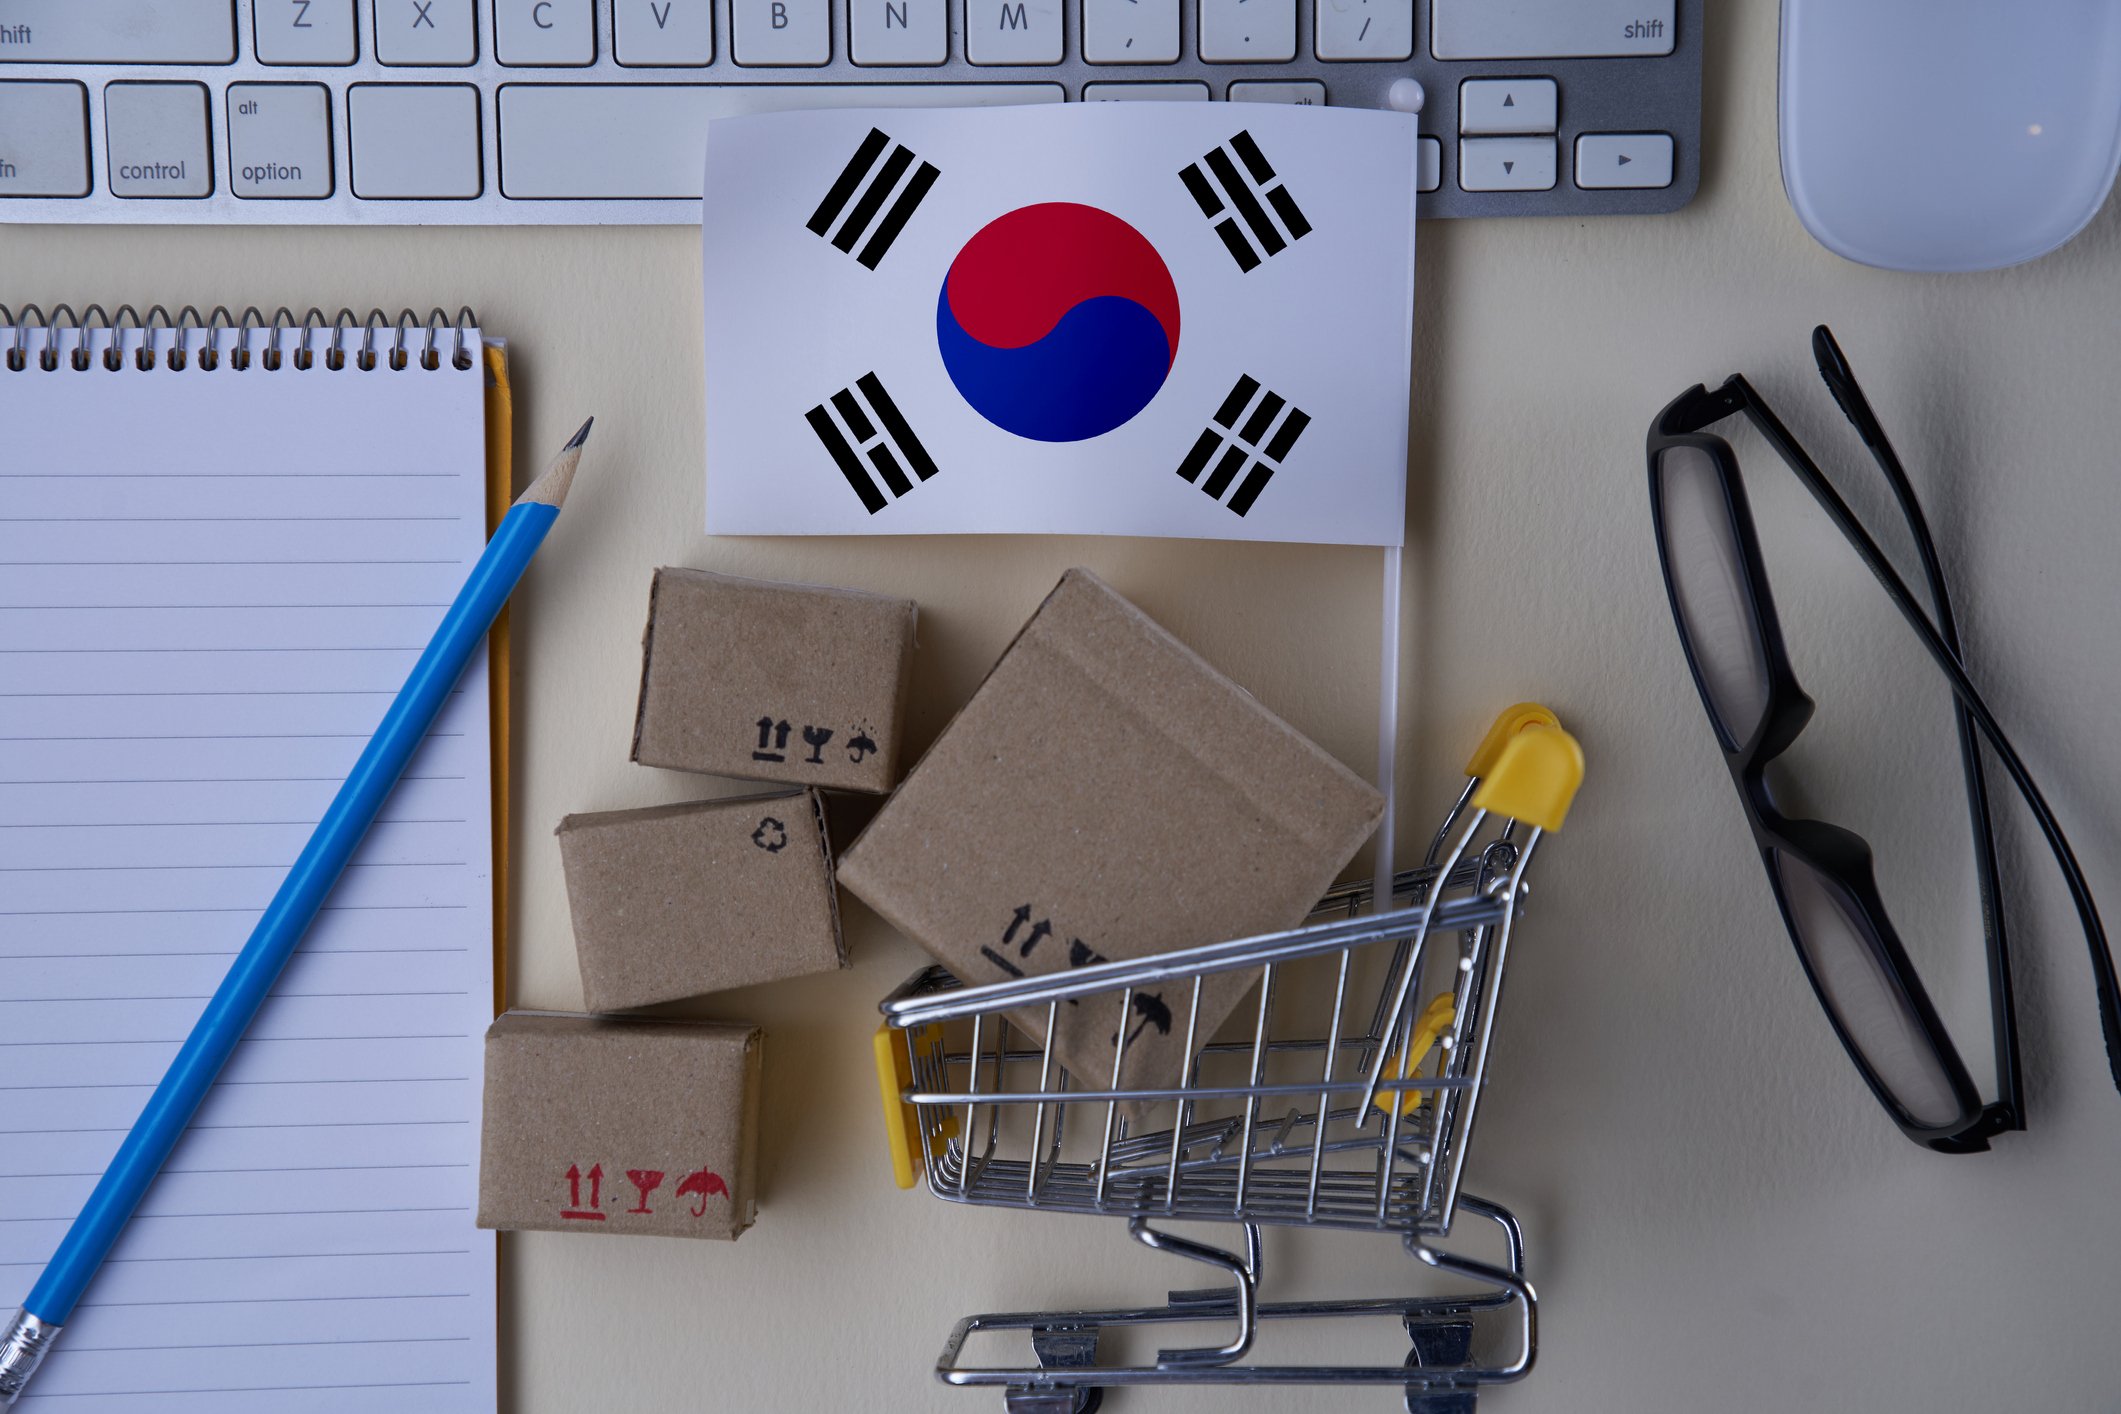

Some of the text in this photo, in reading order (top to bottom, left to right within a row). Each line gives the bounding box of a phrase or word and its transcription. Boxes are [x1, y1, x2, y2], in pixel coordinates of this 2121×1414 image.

[292, 0, 312, 28] Z
[412, 1, 435, 29] X
[532, 1, 553, 29] C
[650, 2, 671, 30] V
[771, 2, 789, 30] B
[885, 1, 907, 29] N
[999, 3, 1028, 31] M
[0, 24, 32, 44] hift
[1624, 19, 1664, 39] shift
[238, 100, 258, 115] alt
[0, 158, 16, 178] fn
[119, 160, 185, 180] control
[242, 162, 302, 185] option
